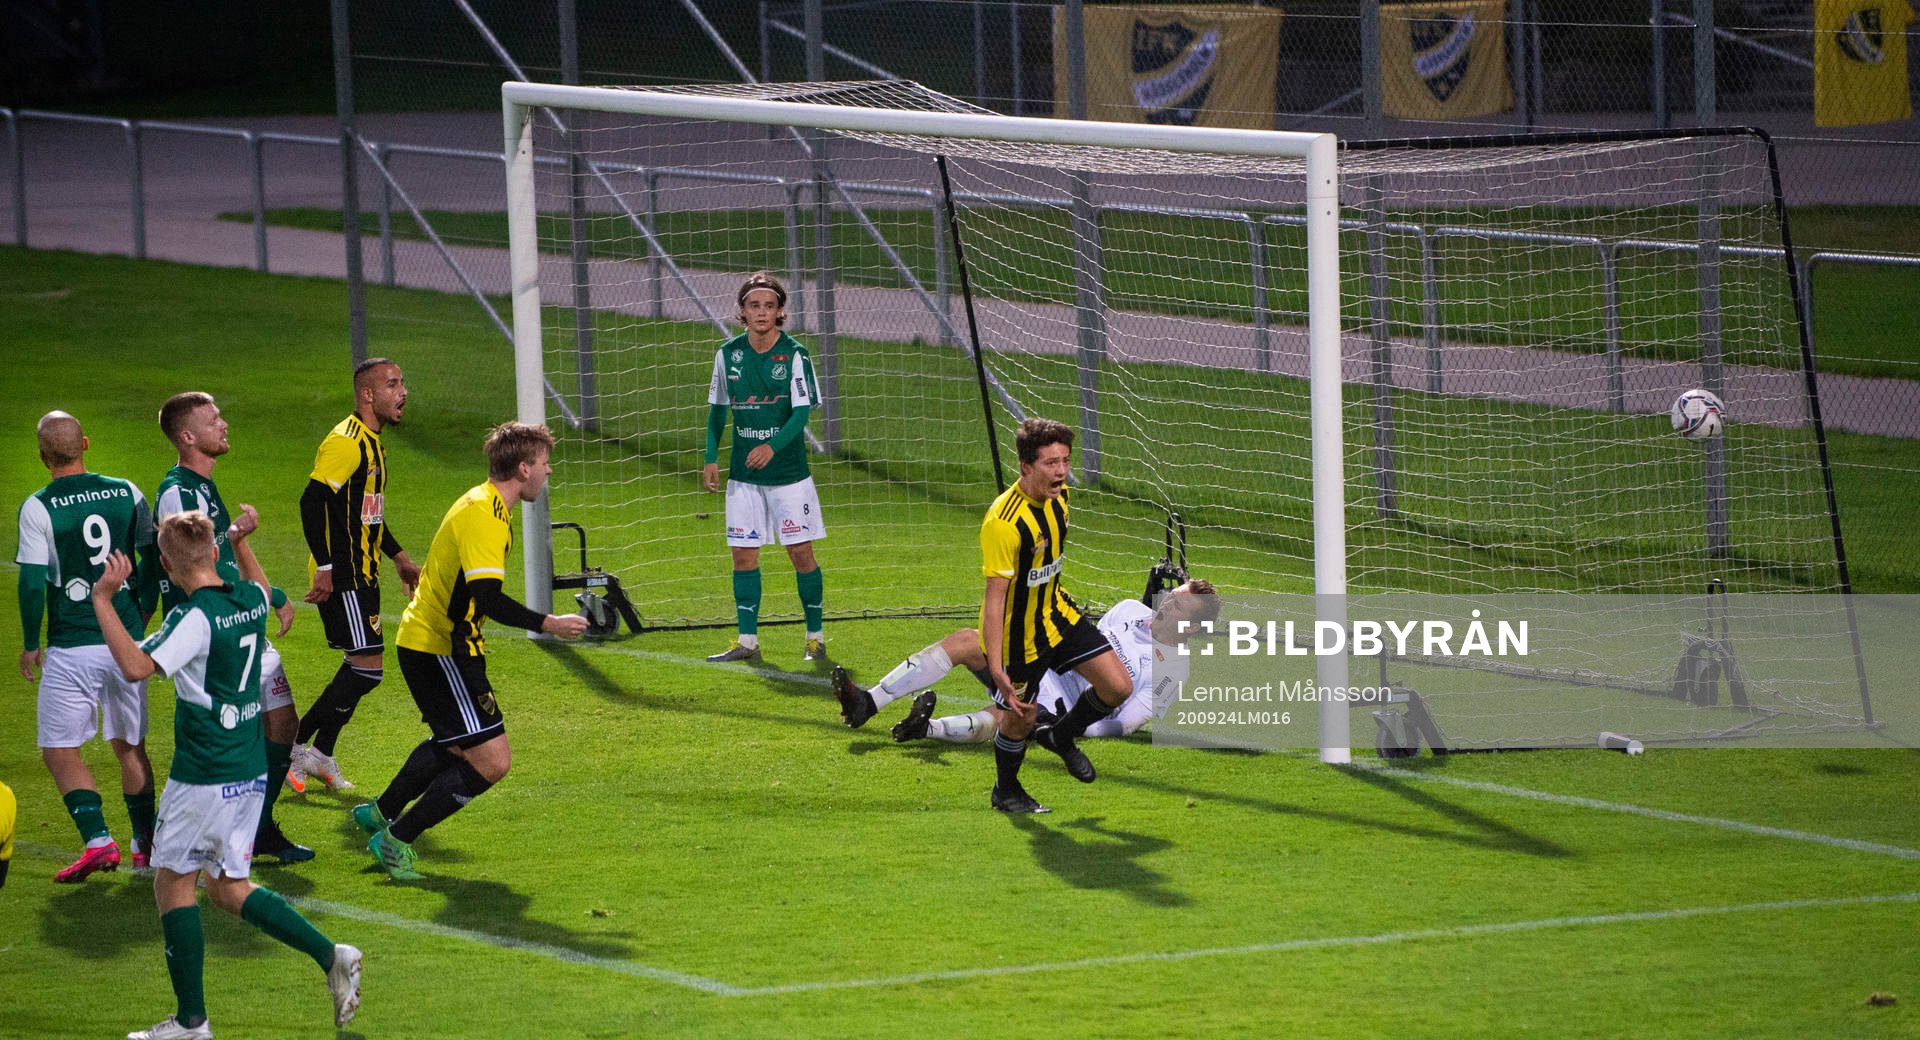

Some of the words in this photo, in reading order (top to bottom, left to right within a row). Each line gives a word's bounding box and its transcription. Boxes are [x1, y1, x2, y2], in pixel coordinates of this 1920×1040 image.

[50, 488, 128, 509] furninova
[803, 504, 810, 515] 8
[83, 514, 111, 565] 9
[238, 632, 257, 693] 7
